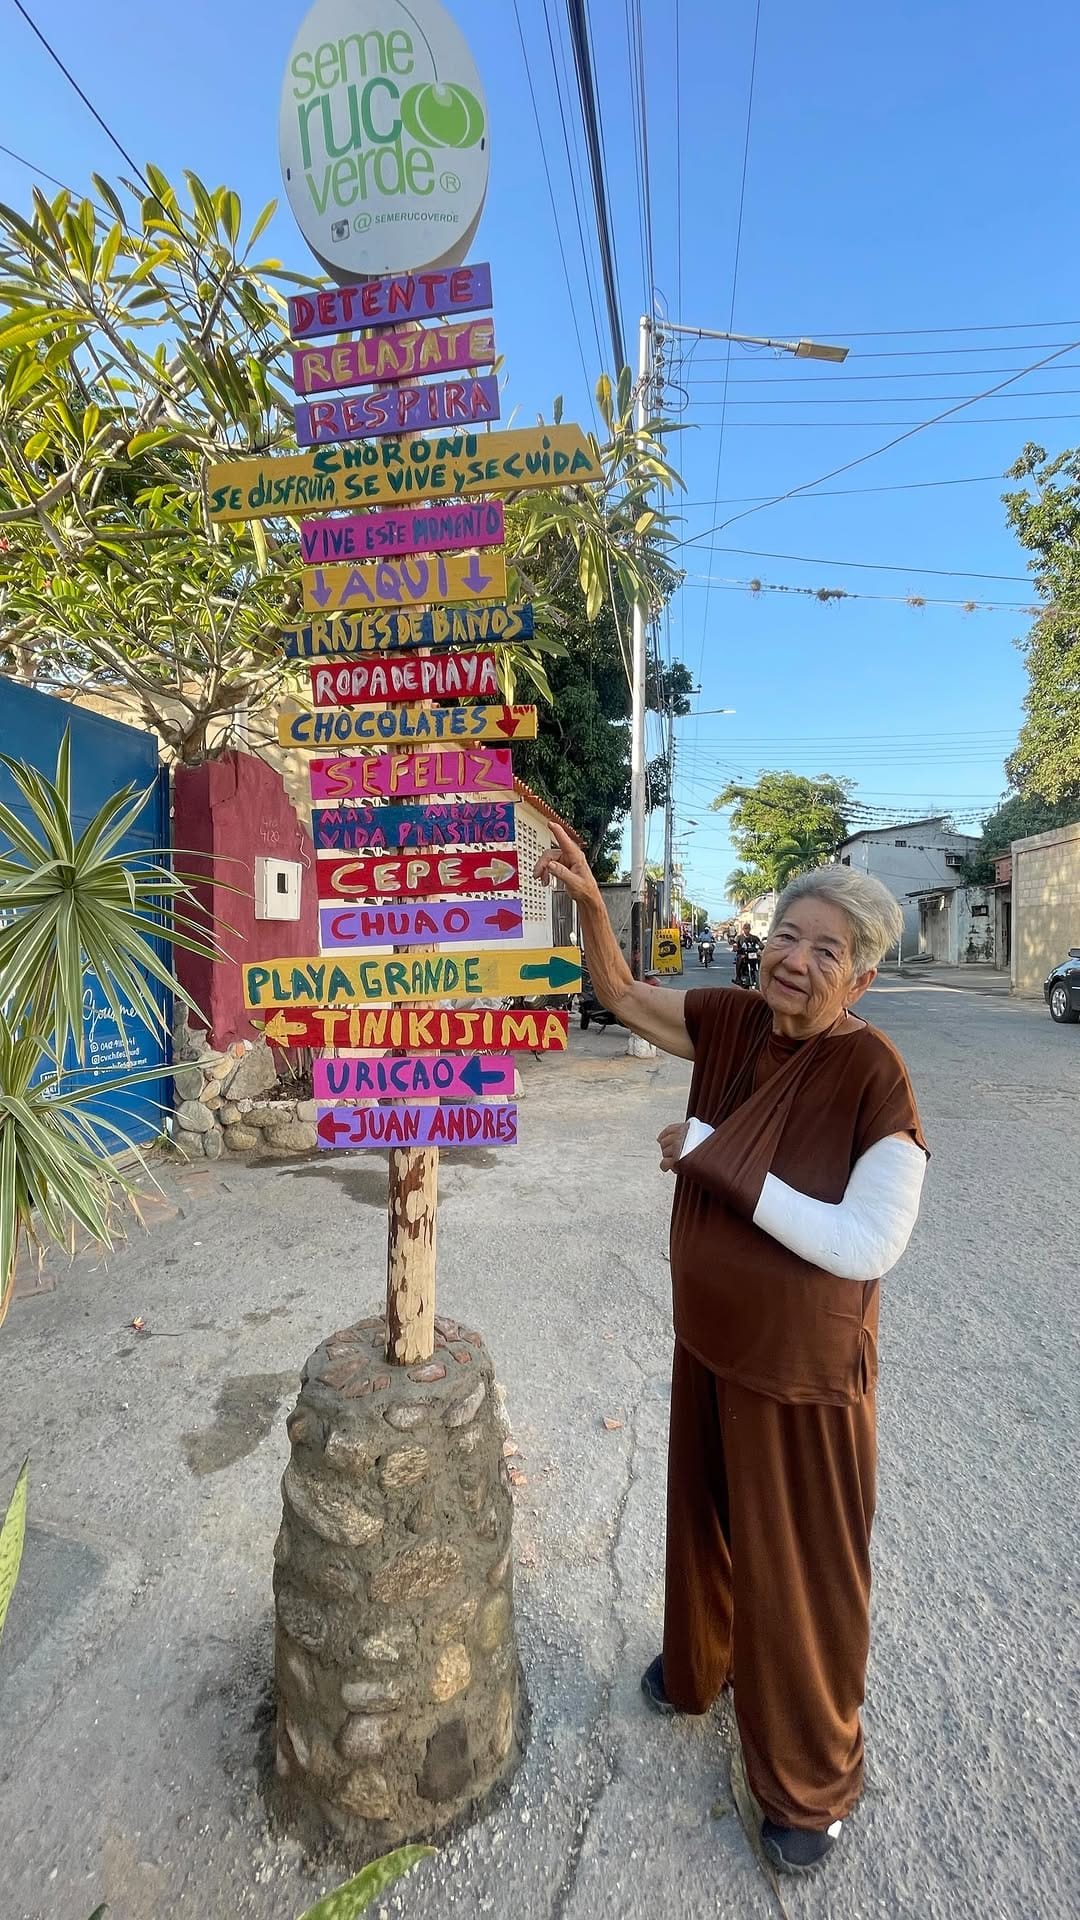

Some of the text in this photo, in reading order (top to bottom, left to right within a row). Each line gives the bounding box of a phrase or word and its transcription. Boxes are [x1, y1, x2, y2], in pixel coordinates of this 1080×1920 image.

[291, 30, 414, 99] seme
[306, 133, 435, 216] verde
[292, 270, 474, 333] DETENTE
[302, 325, 495, 391] RELAJATE
[309, 379, 492, 440] RESPIRA
[313, 434, 478, 473] CHORONI
[209, 485, 243, 513] SE
[344, 473, 381, 500] SE
[387, 463, 446, 493] VIVE
[466, 458, 501, 485] SE
[303, 505, 501, 557] VIVE ESTE MOMENTO
[337, 559, 449, 606] AQUI
[282, 611, 392, 655] TRAJES
[396, 612, 424, 646] DE
[314, 664, 389, 705] ROPA
[420, 655, 498, 695] PLAYA
[290, 706, 488, 743] CHOCOLATES
[318, 818, 510, 848] VIDA PLASTICO
[320, 806, 375, 825] MAS
[331, 858, 471, 893] CEPE
[331, 908, 471, 940] CHUAO
[247, 956, 482, 1005] PLAYA GRANDE
[311, 1009, 569, 1051] TINIKIJIMA
[326, 1058, 455, 1095] URICAO
[349, 1106, 518, 1143] JUAN ANDRES
